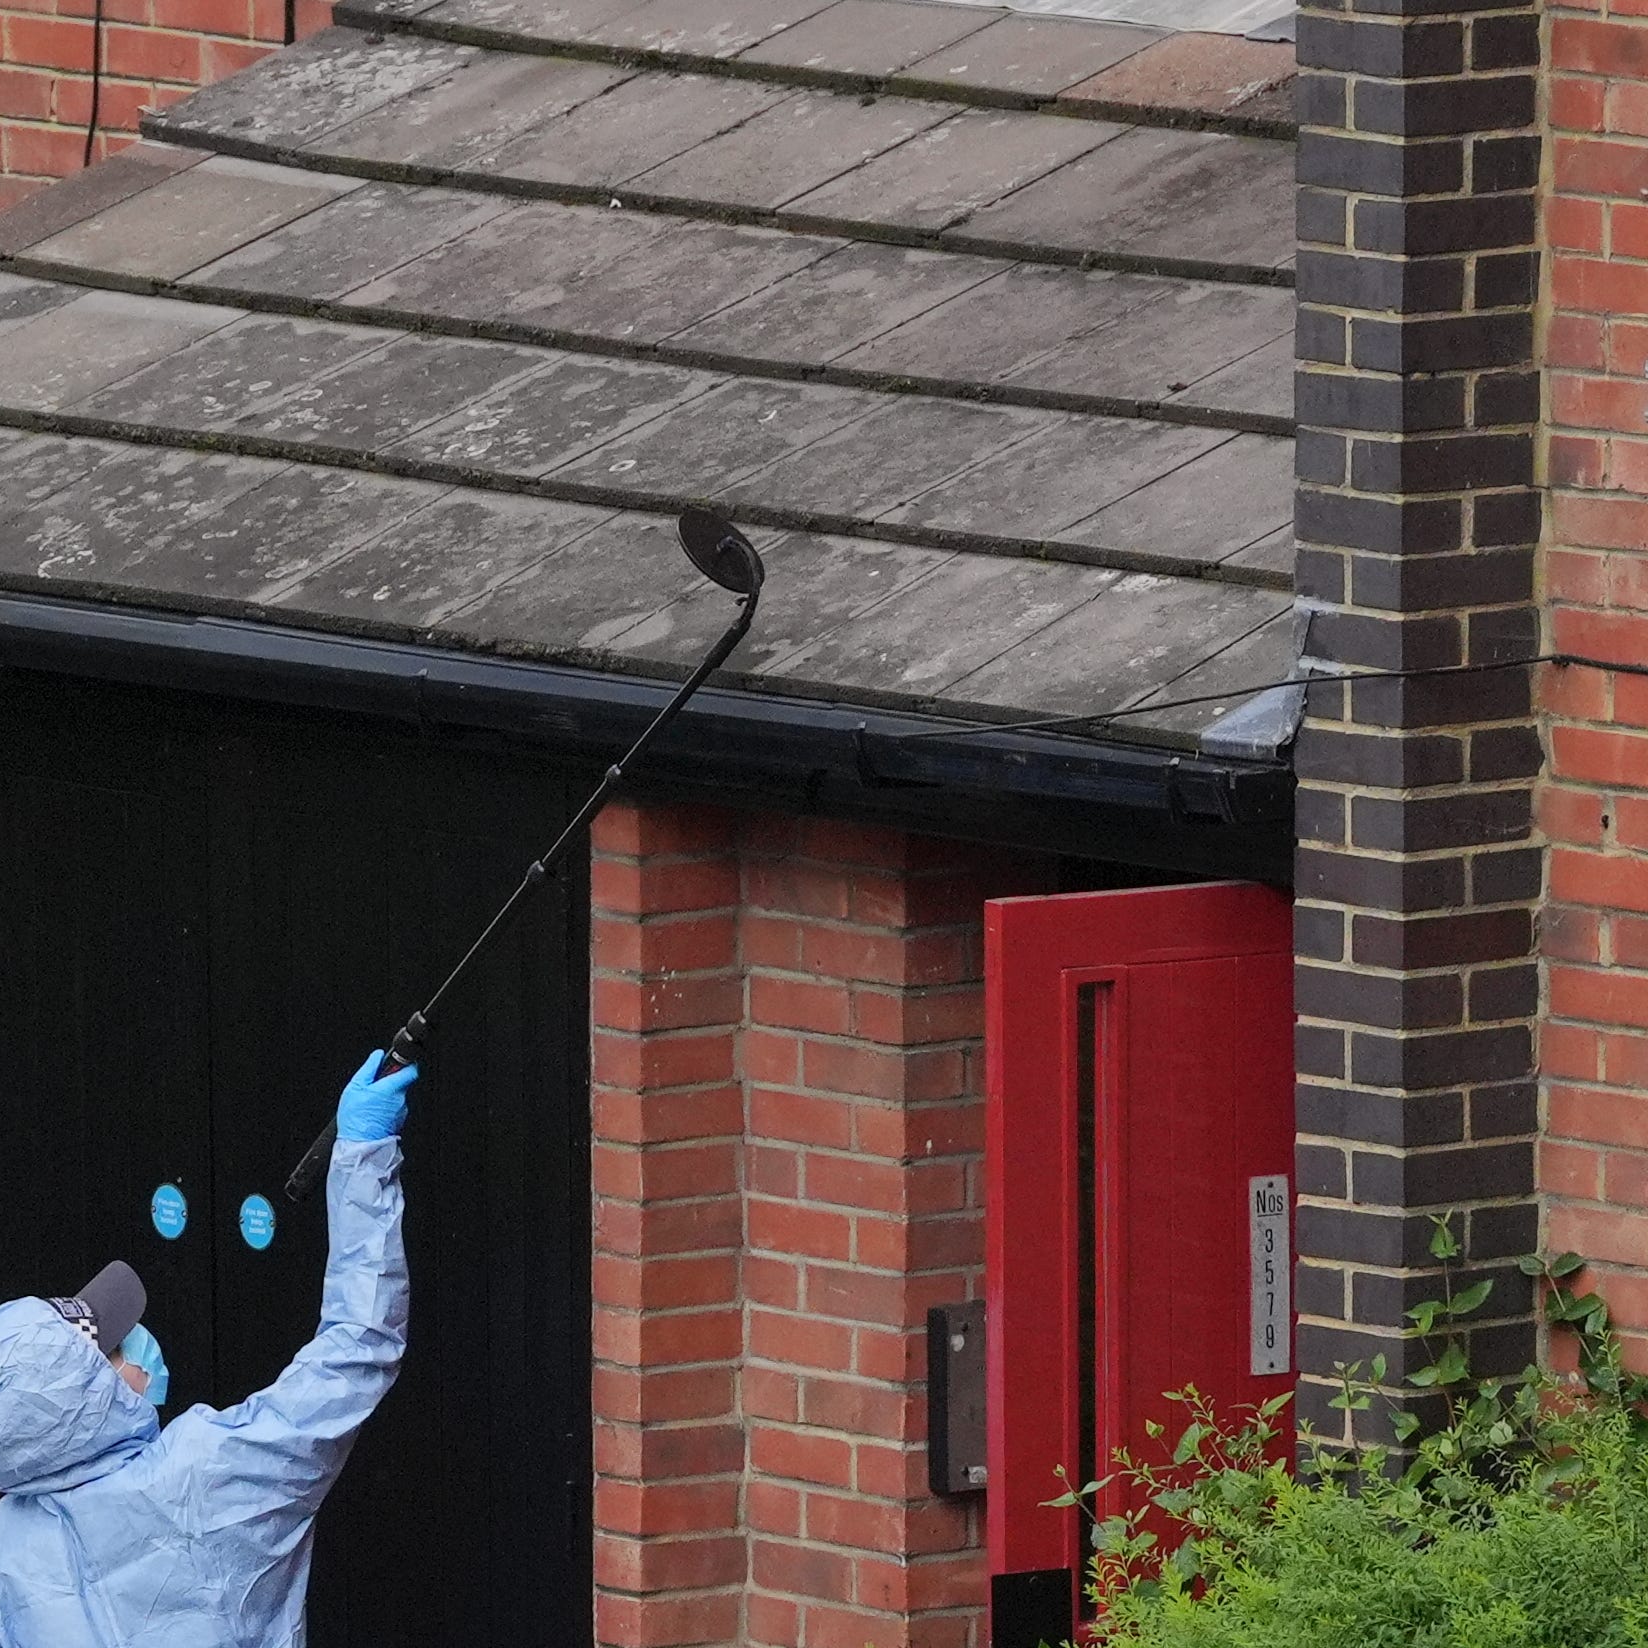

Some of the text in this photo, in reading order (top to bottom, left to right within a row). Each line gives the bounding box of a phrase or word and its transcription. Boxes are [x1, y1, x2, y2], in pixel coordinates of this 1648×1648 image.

[1256, 1190, 1283, 1213] Nos
[1265, 1228, 1273, 1253] 3
[1265, 1260, 1274, 1285] 5
[1266, 1292, 1274, 1316] 7
[1266, 1324, 1274, 1349] 9
